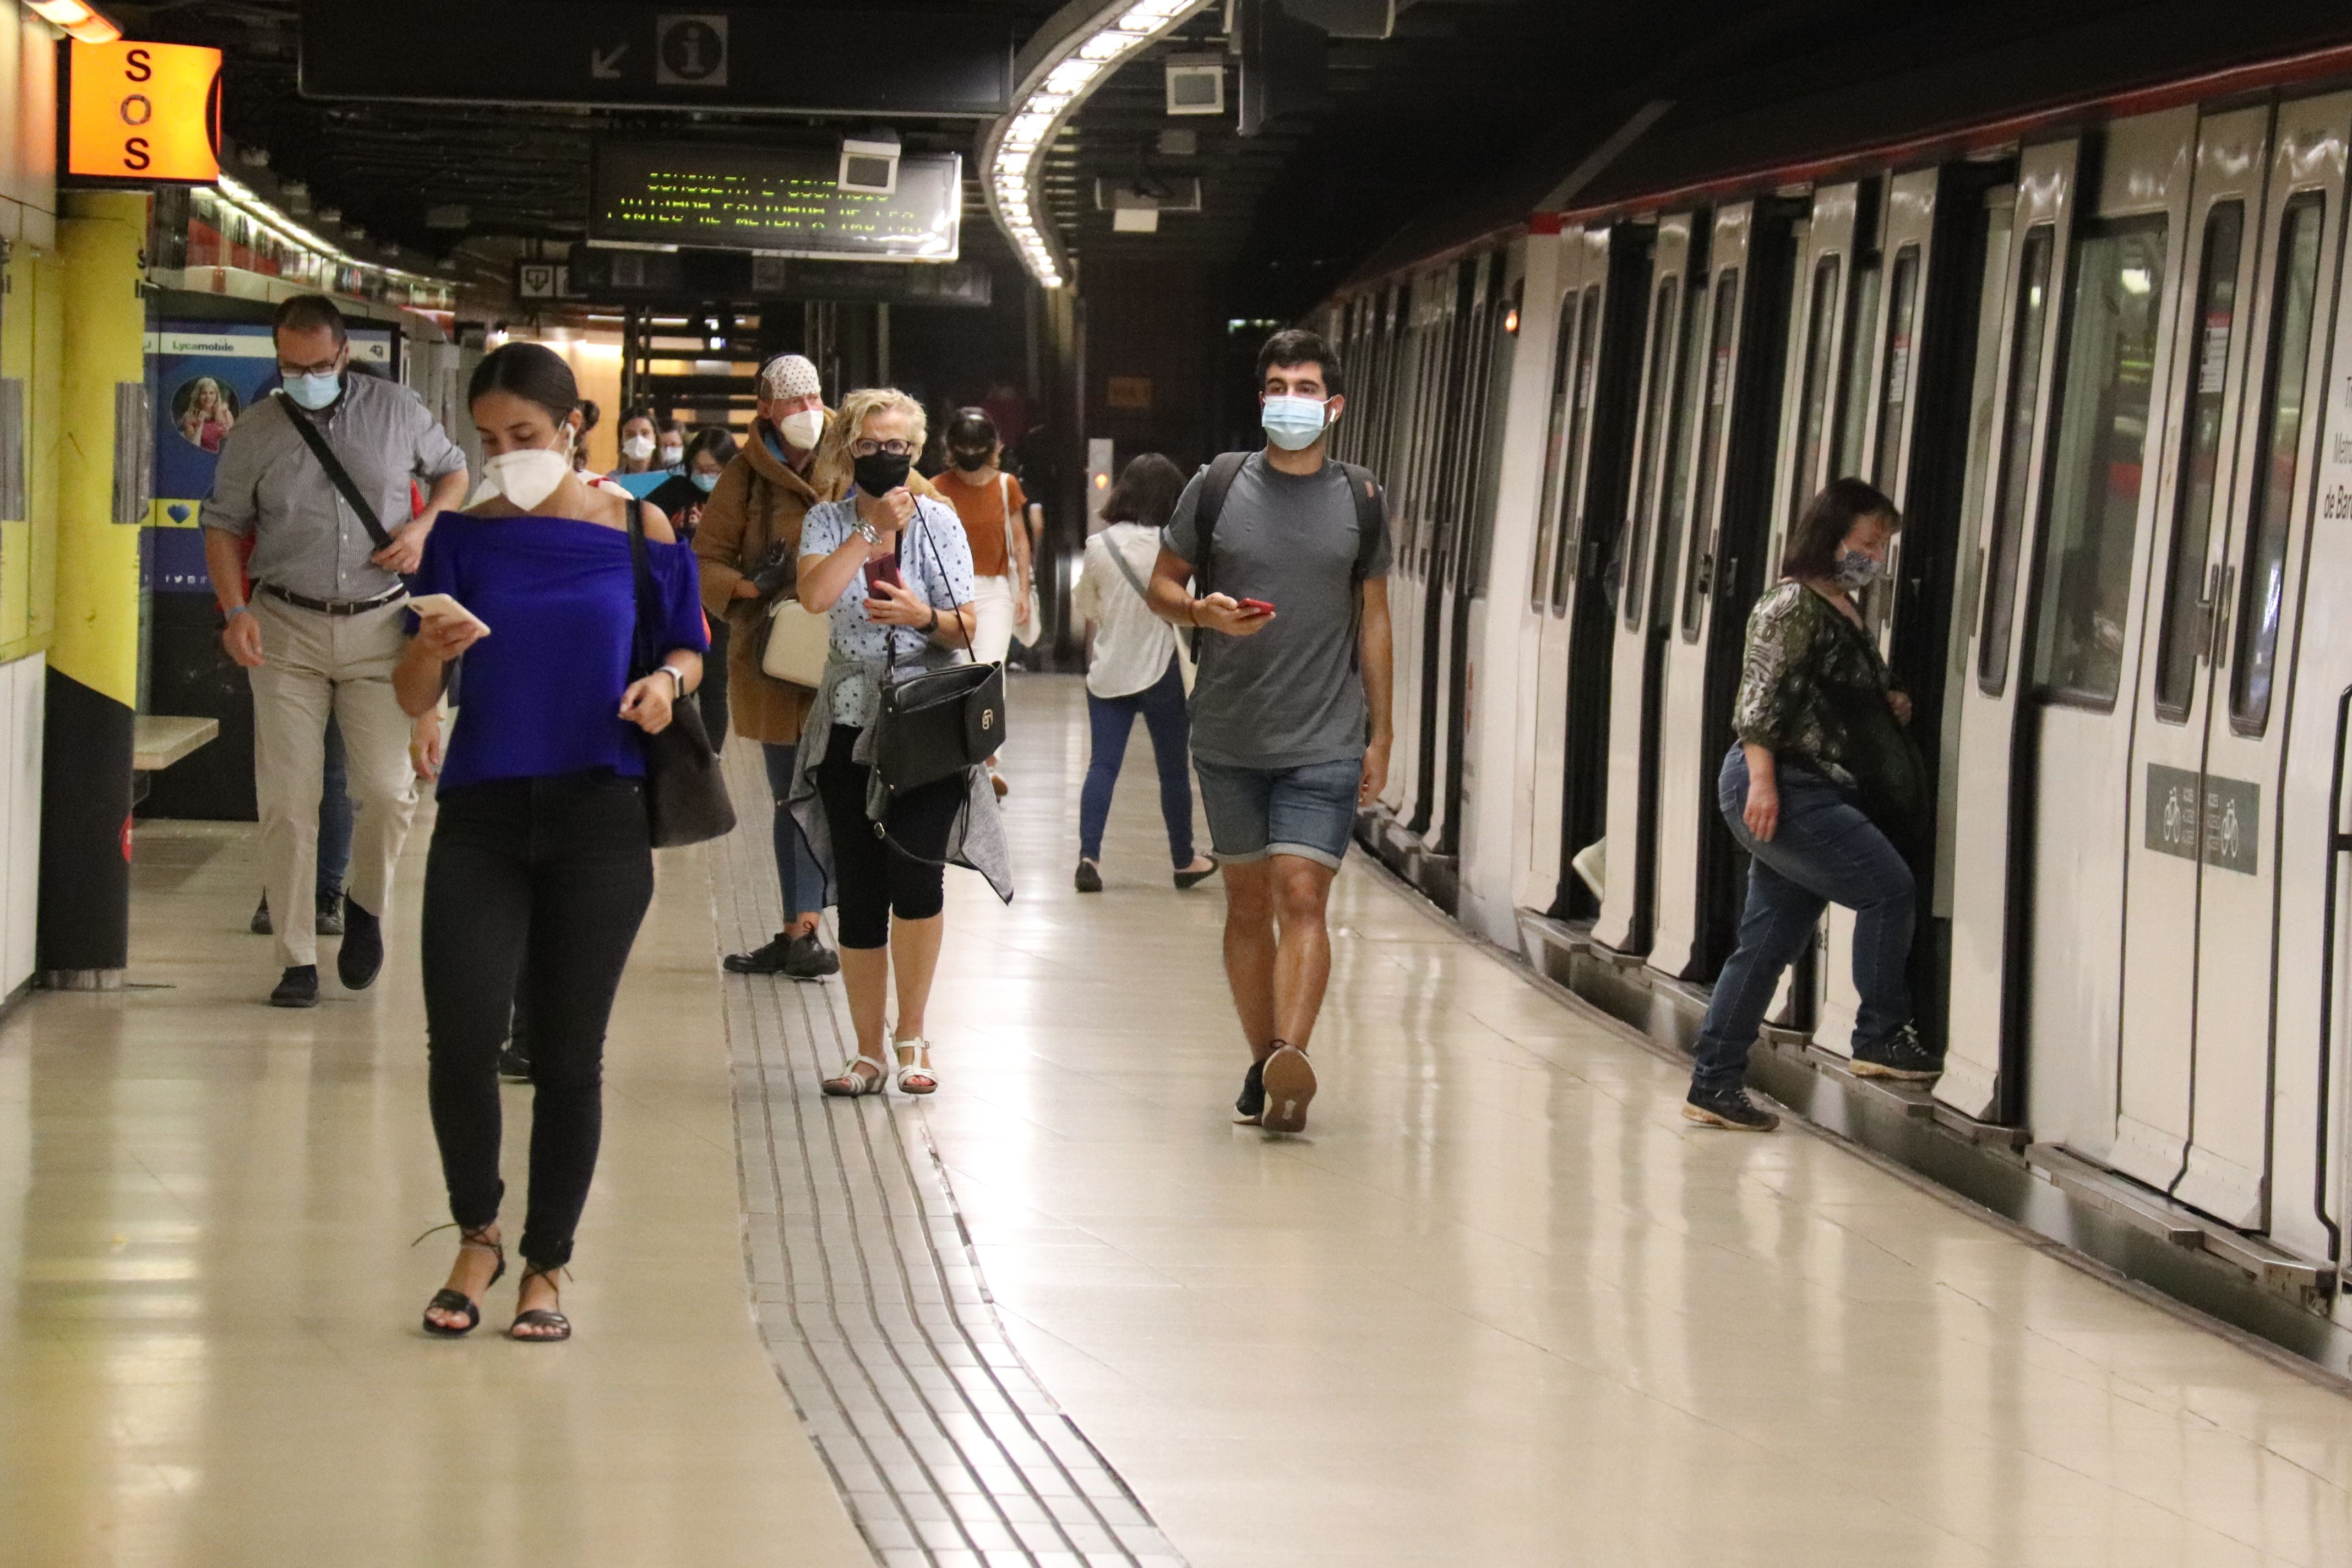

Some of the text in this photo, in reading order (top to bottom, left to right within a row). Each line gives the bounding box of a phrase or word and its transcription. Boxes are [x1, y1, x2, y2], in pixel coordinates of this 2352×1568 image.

[121, 48, 151, 171] SOS
[173, 340, 234, 351] Lycamobile
[2324, 484, 2335, 519] de
